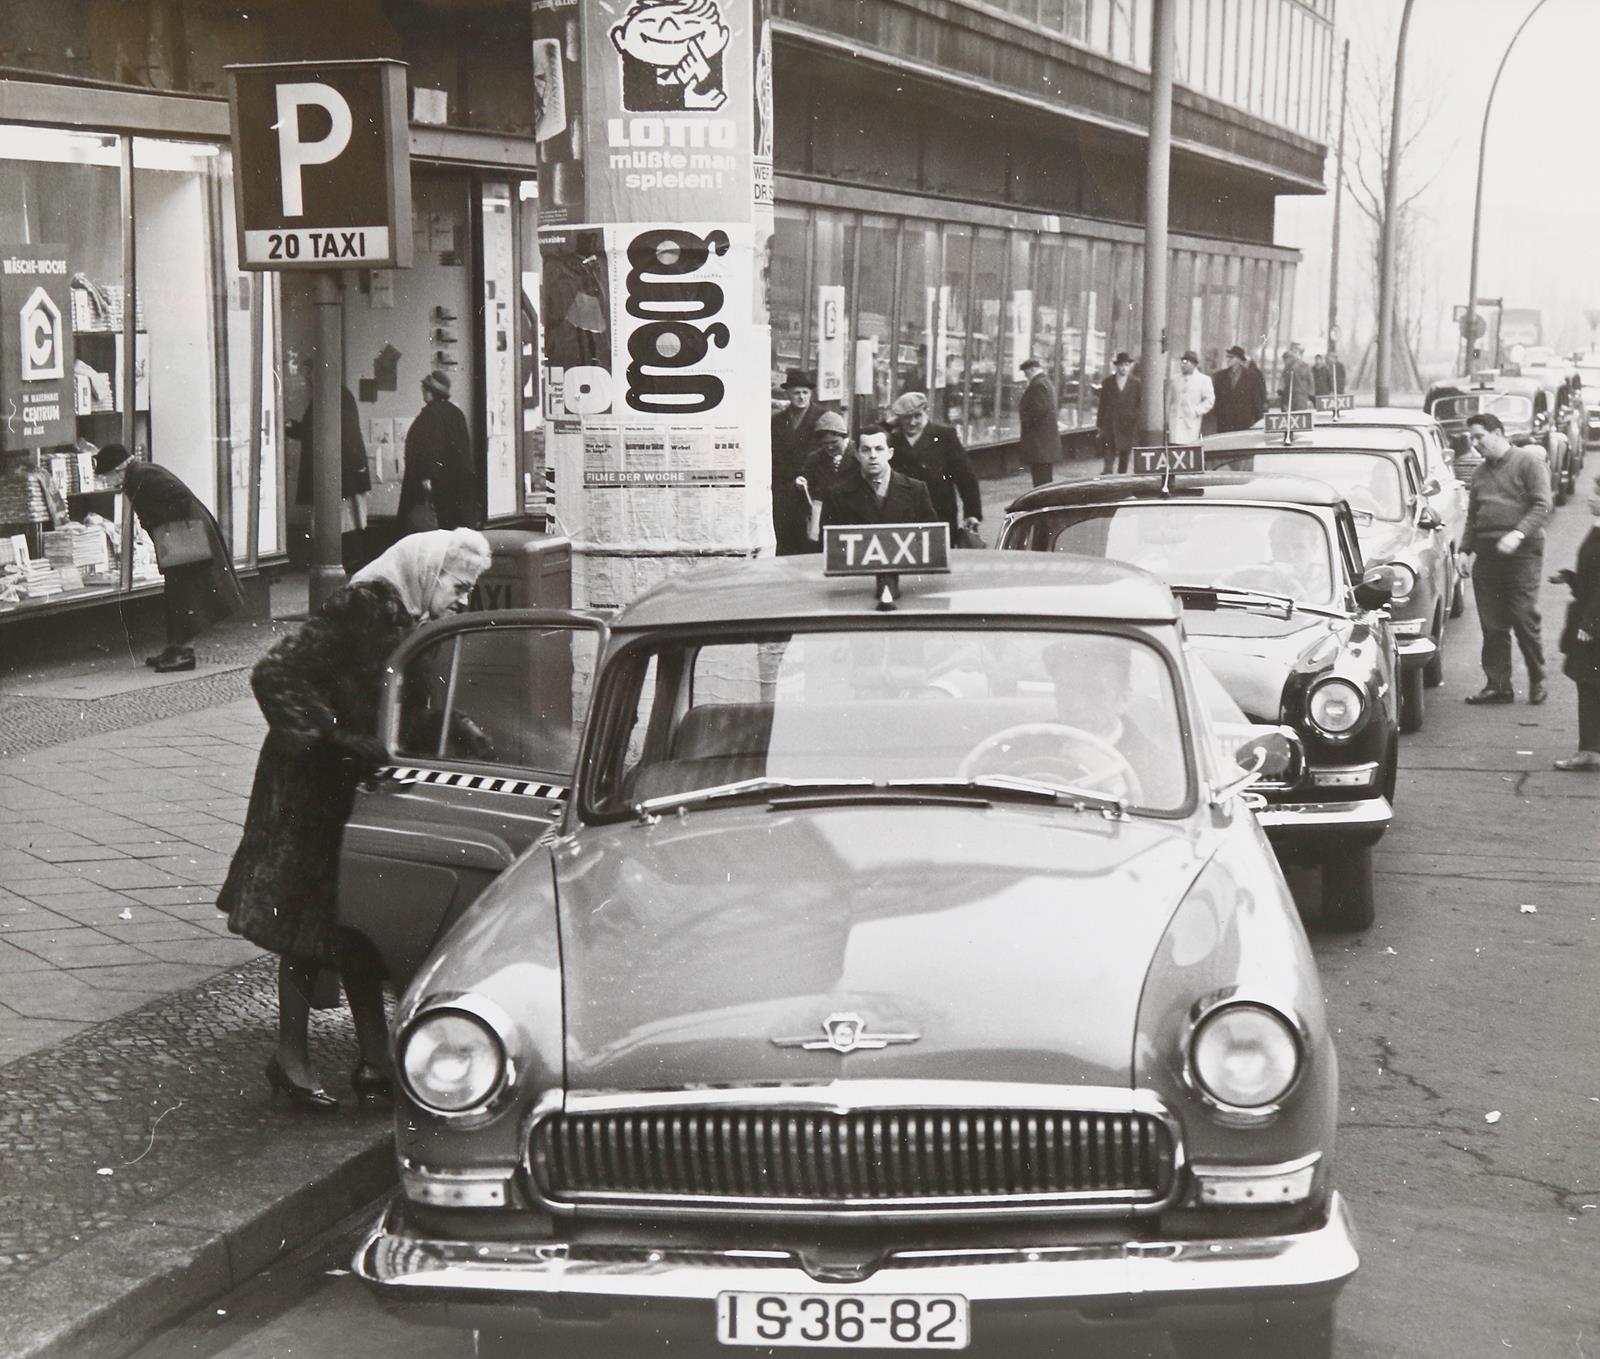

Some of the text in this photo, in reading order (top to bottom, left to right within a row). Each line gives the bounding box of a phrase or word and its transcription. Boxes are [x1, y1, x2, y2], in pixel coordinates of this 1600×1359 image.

[607, 118, 737, 148] LOTTO
[275, 82, 353, 217] P
[690, 154, 737, 170] man
[625, 171, 723, 191] spielen!
[268, 232, 366, 259] 20 TAXI
[1320, 396, 1351, 409] TAXI
[1269, 414, 1307, 431] TAXI
[1140, 450, 1195, 471] TAXI
[586, 472, 615, 481] FILME
[619, 472, 641, 481] DER
[644, 472, 685, 481] WOCHE
[838, 530, 930, 566] TAXI
[470, 584, 512, 611] AXI
